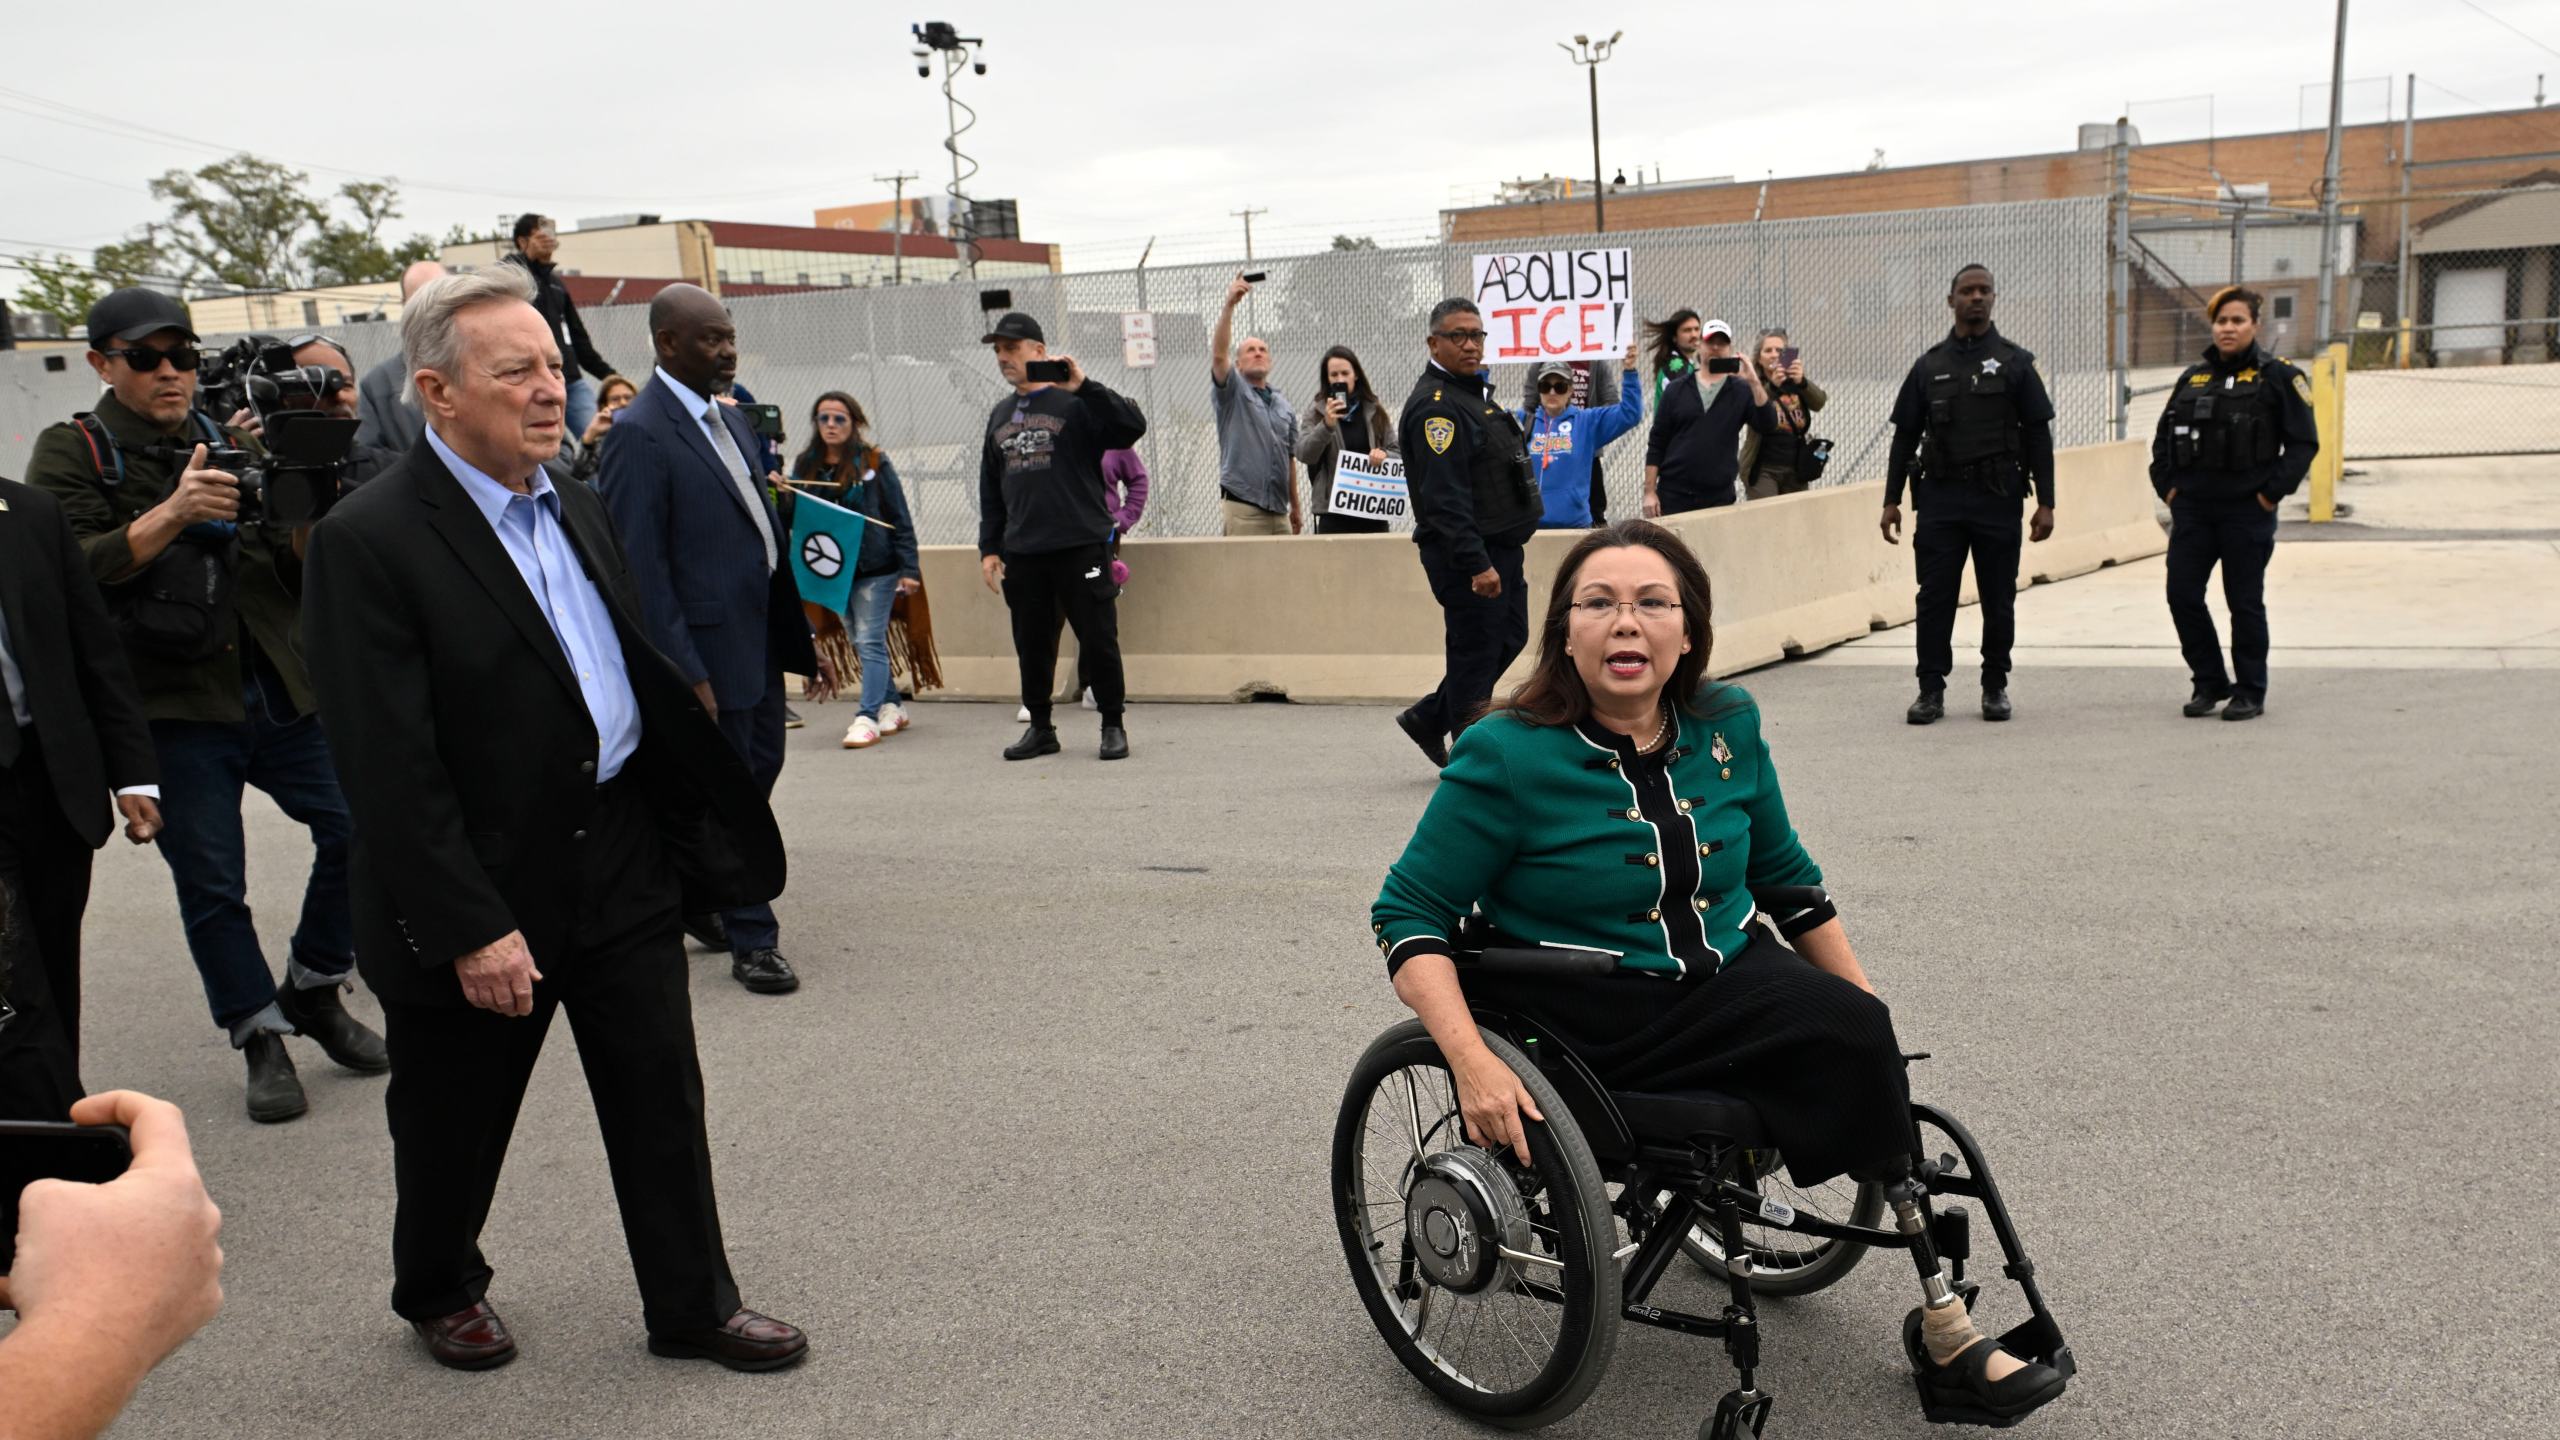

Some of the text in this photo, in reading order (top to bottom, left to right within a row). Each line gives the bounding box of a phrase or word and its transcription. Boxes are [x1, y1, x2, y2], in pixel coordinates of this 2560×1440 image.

[1478, 251, 1629, 303] ABOLISH
[1492, 303, 1625, 357] ICE!
[1335, 490, 1406, 517] CHICAGO
[1649, 1309, 1661, 1321] 2
